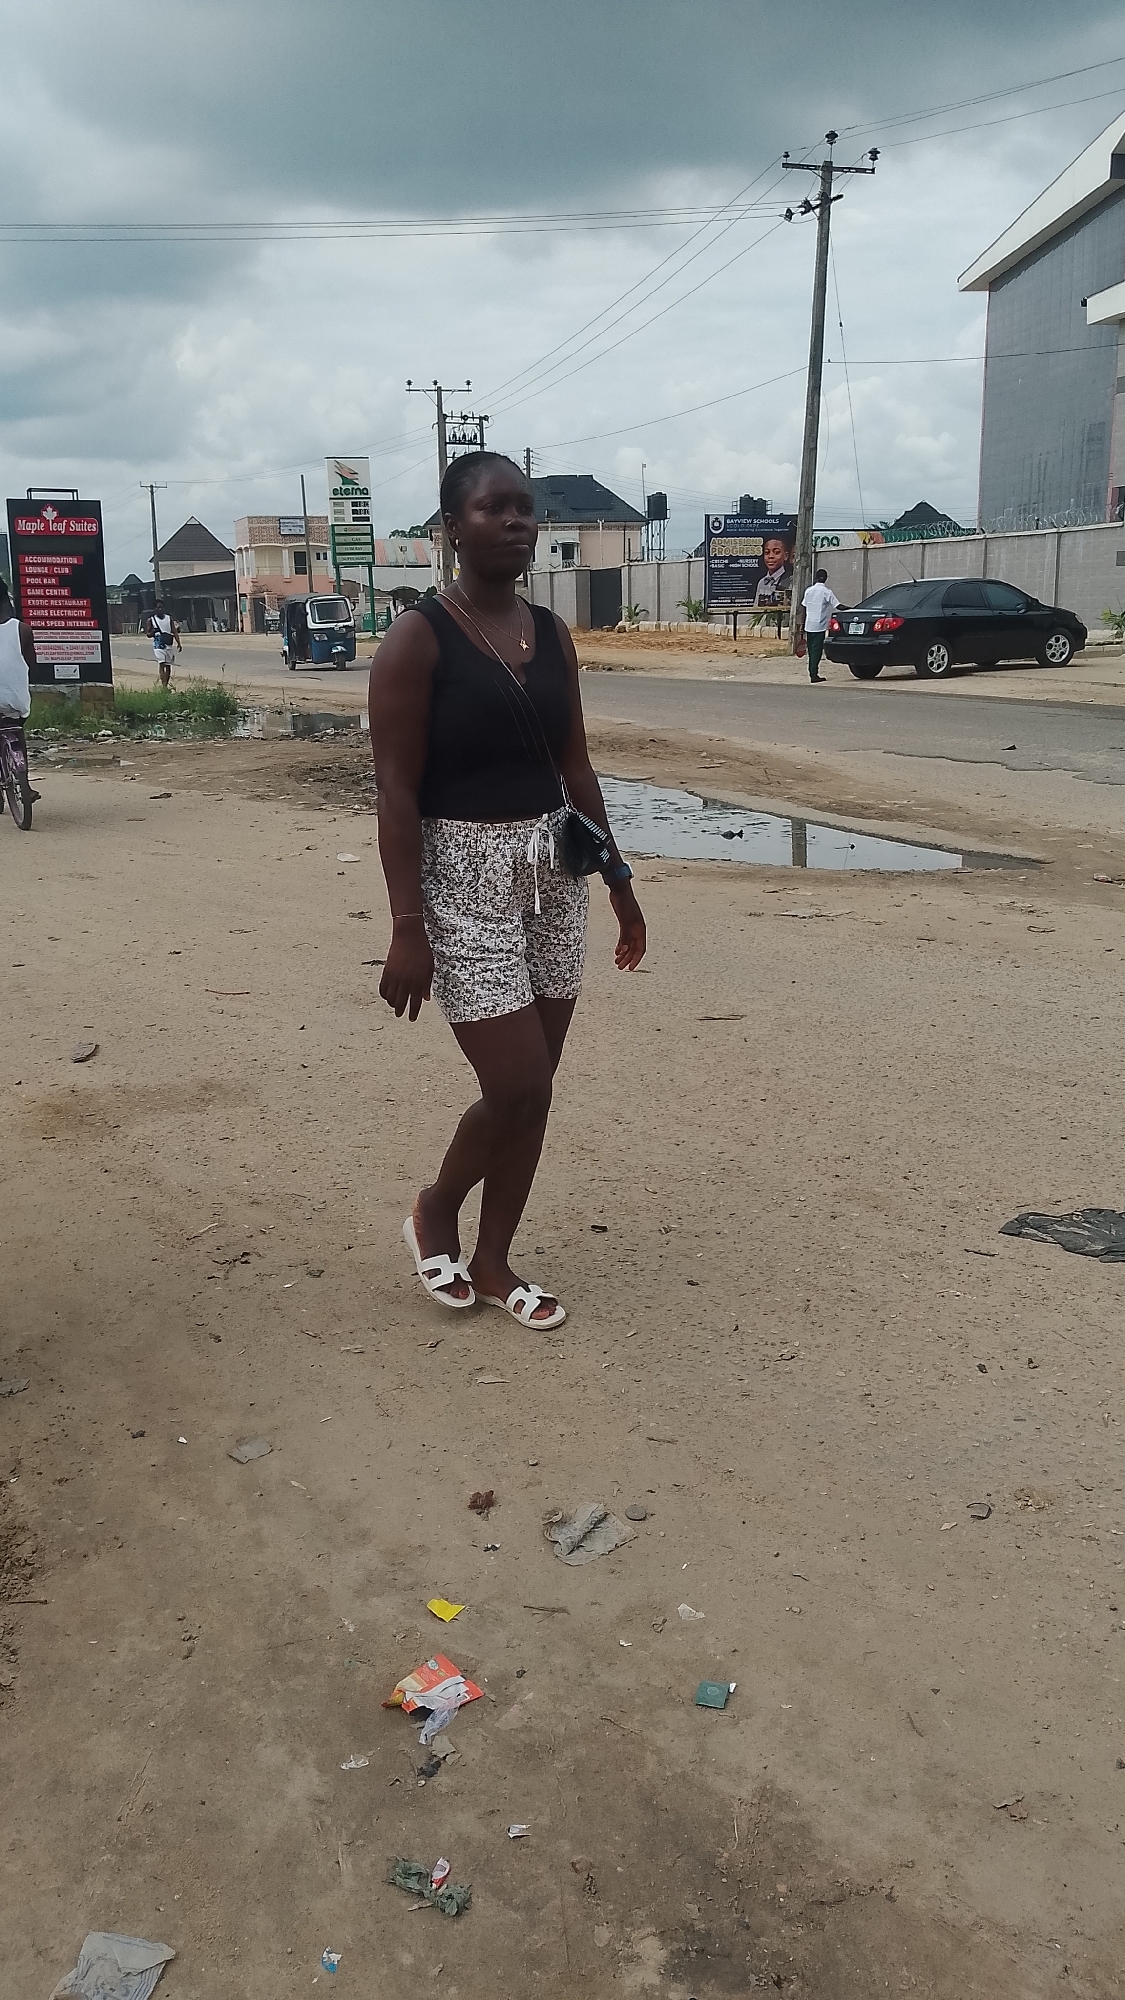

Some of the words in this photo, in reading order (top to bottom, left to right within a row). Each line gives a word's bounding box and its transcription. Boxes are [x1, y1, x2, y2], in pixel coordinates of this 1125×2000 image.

[332, 486, 369, 496] eterna
[17, 519, 45, 534] Maple
[69, 520, 97, 532] Suites
[711, 538, 763, 546] ADMISSIONS
[711, 547, 763, 556] PROGRESS
[24, 556, 78, 564] ACCOMMODATION
[25, 566, 49, 574] LOUNGE
[26, 577, 42, 585] POOL
[27, 588, 45, 596] GAME
[45, 588, 69, 596] CENTRE
[29, 609, 49, 617] 24HRS
[50, 609, 87, 617] ELECTRICITY
[30, 620, 45, 628] HIGH
[46, 620, 66, 628] SPEED
[66, 620, 95, 628] INTERNET
